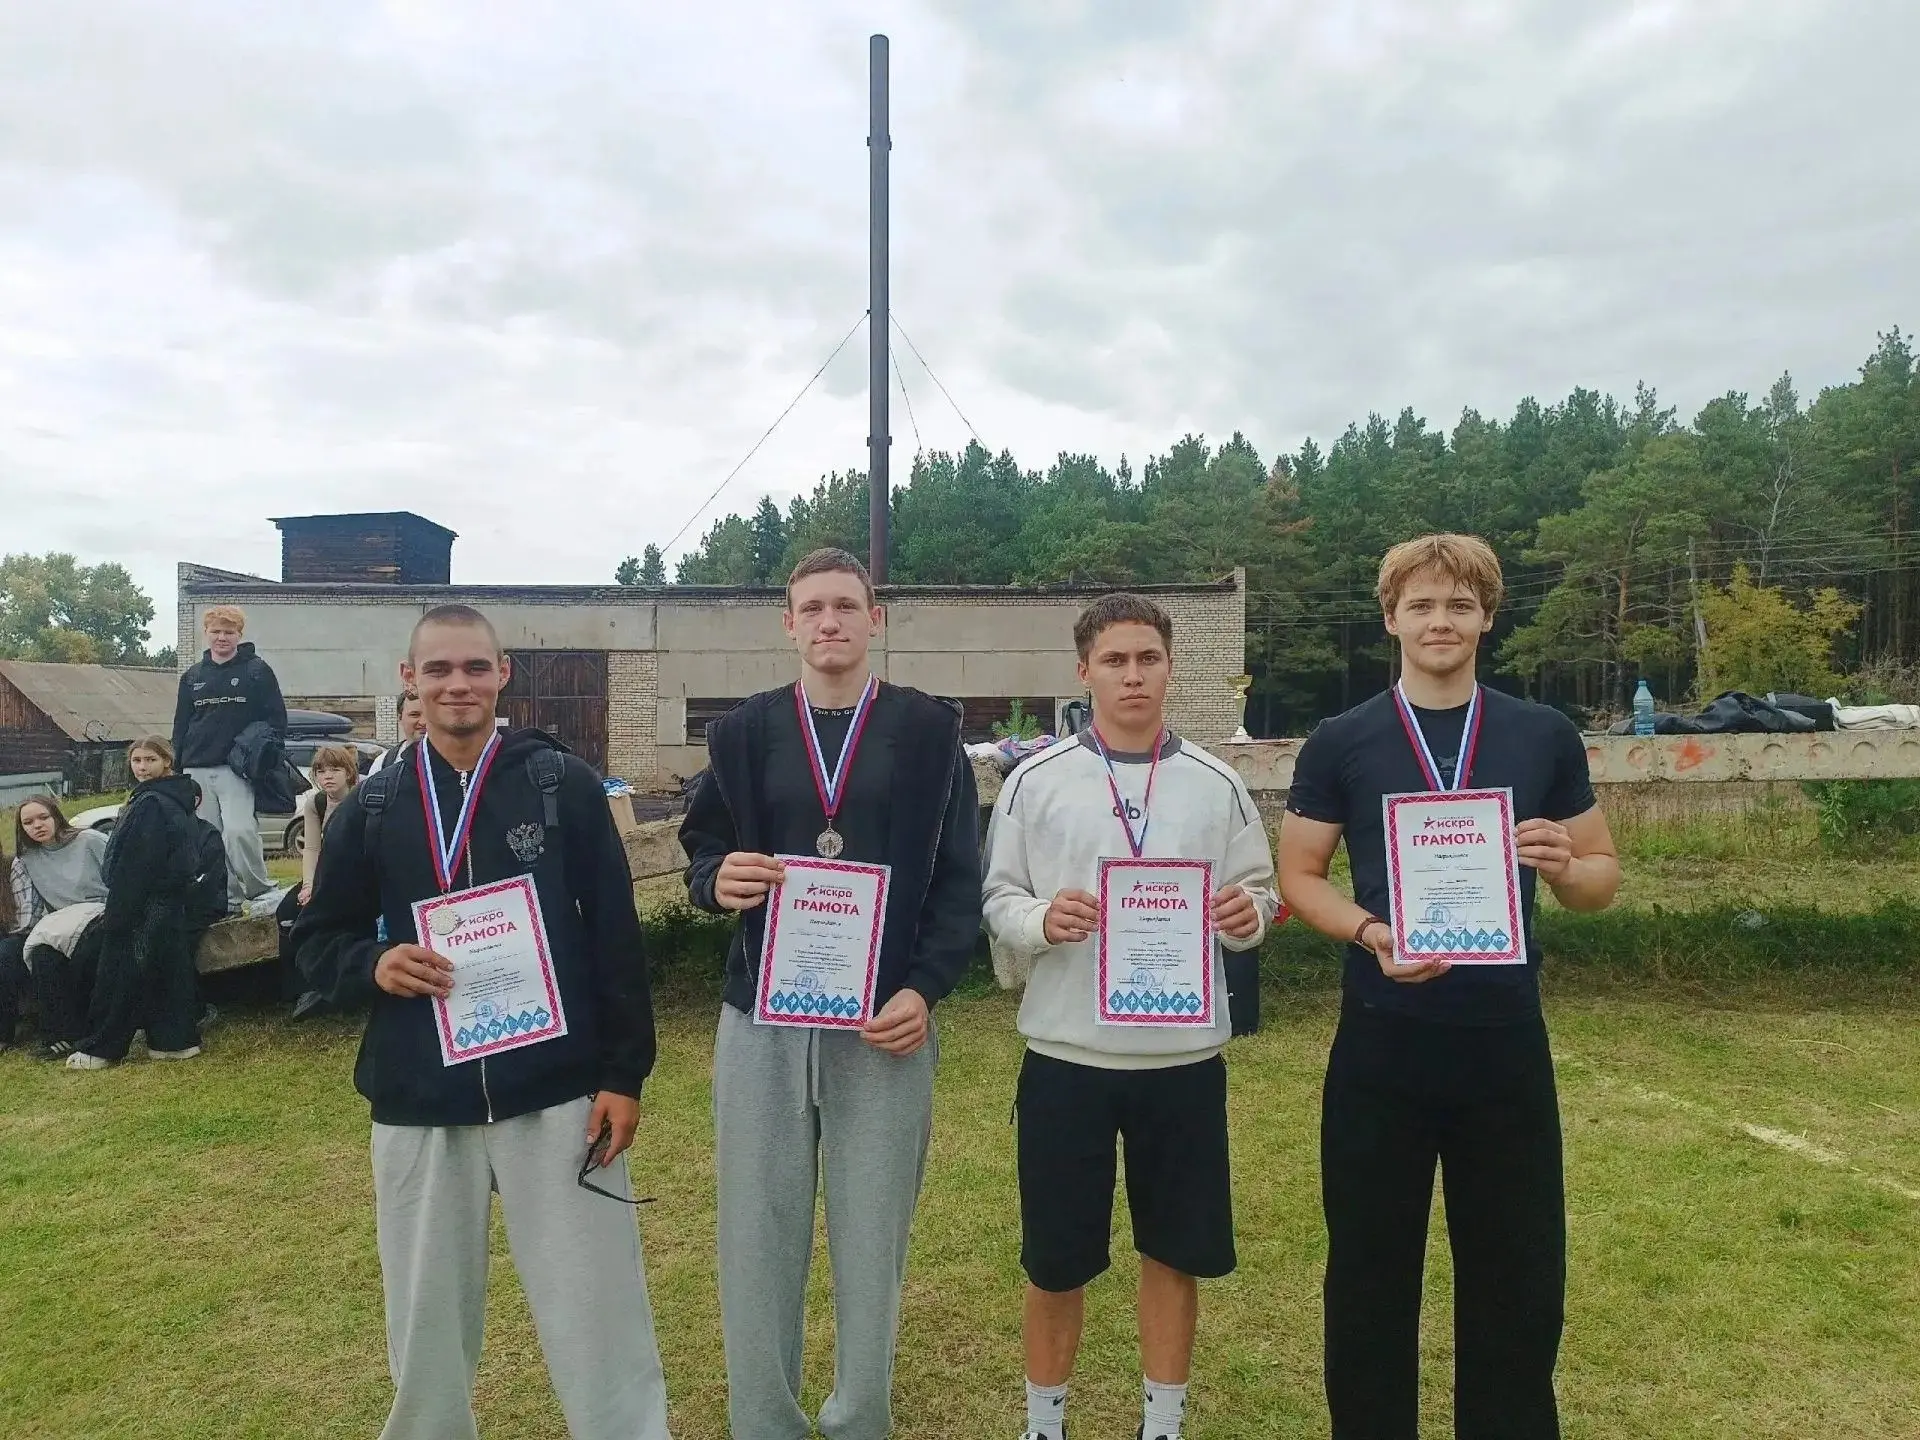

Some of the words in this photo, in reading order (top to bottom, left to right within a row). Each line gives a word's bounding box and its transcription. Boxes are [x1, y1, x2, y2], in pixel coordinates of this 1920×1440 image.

[1437, 818, 1475, 829] искра
[1412, 833, 1487, 847] ГРАМОТА
[819, 887, 853, 899] искра
[1145, 884, 1180, 895] искра
[793, 898, 861, 916] ГРАМОТА
[1121, 897, 1189, 910] ГРАМОТА
[468, 911, 504, 925] искра
[446, 921, 518, 948] ГРАМОТА
